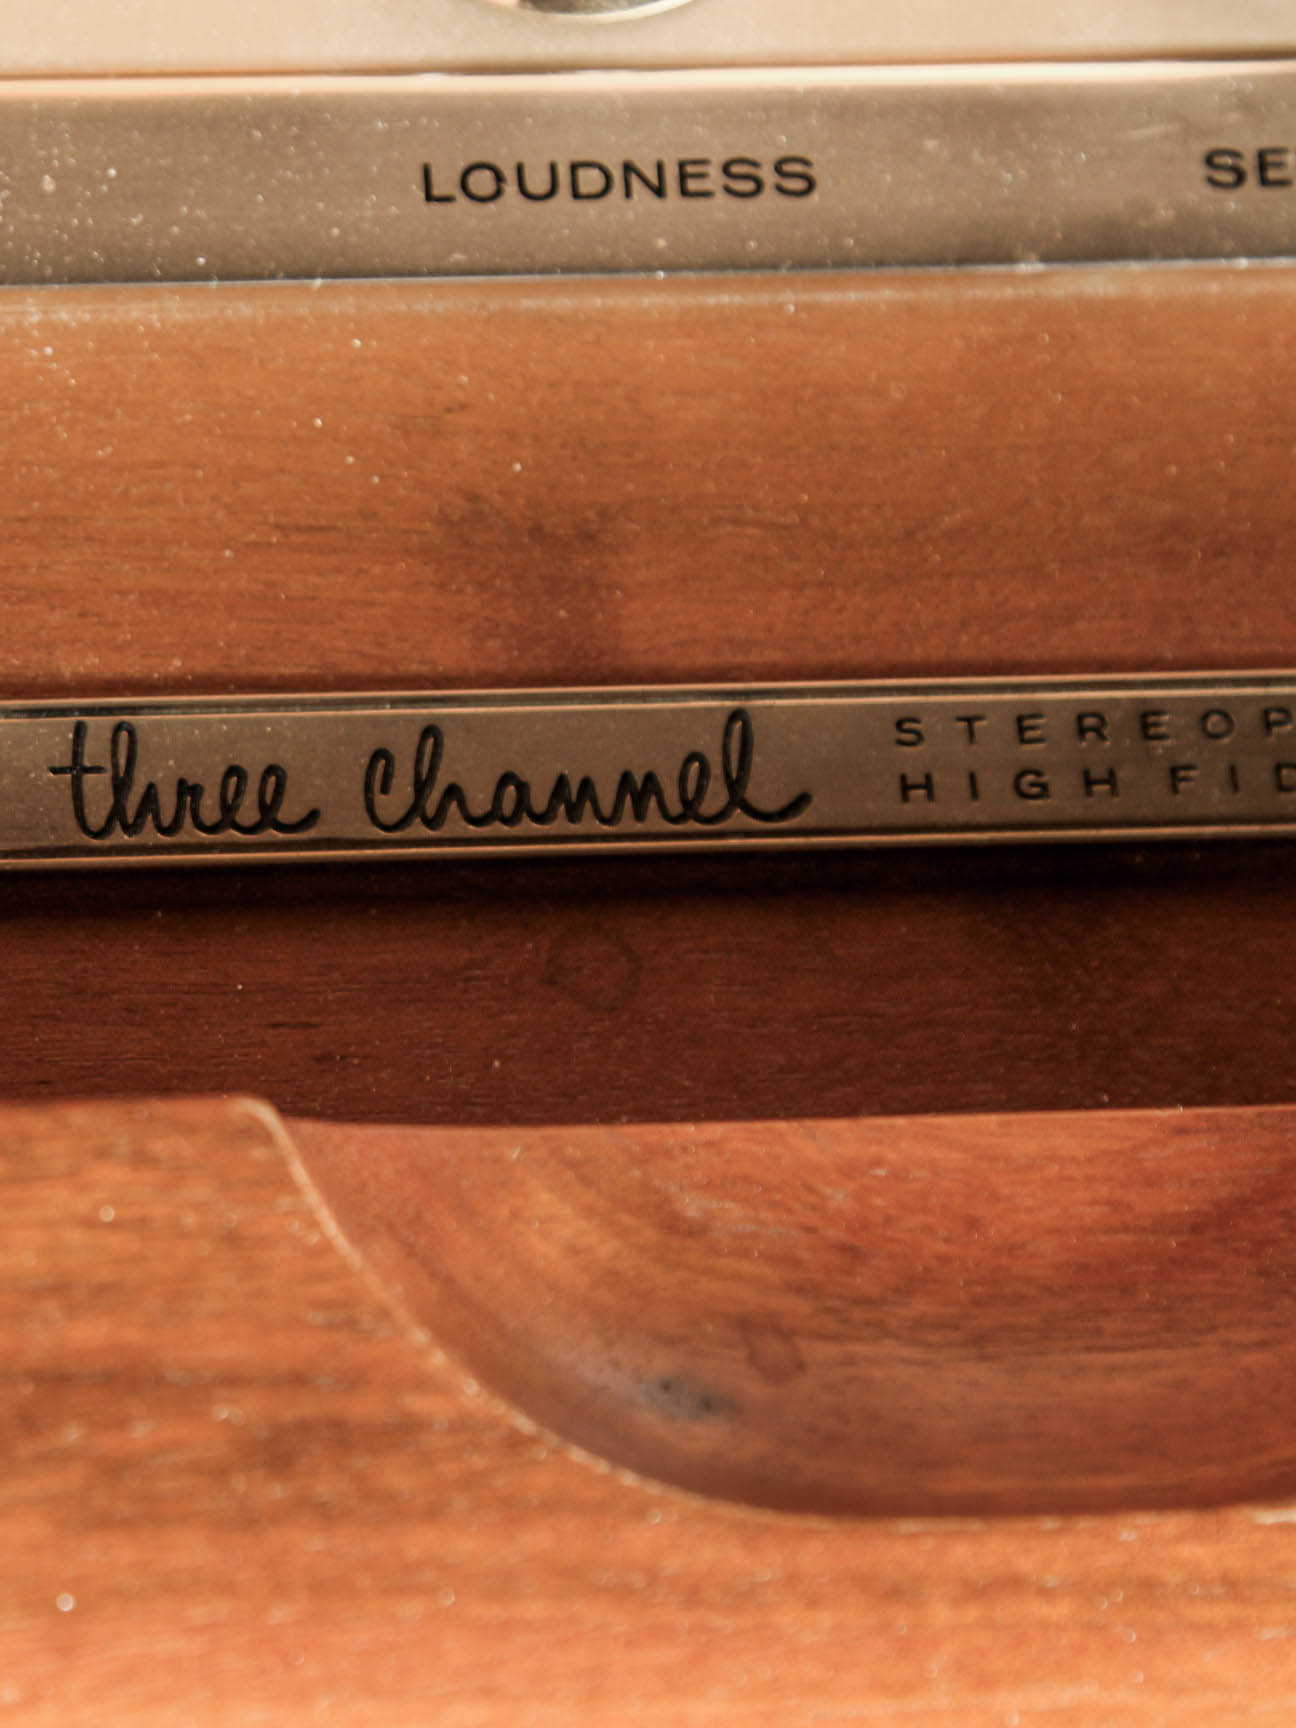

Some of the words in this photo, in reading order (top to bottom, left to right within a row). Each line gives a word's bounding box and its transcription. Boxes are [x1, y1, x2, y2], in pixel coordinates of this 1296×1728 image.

[422, 156, 817, 203] LOUDNESS
[1204, 148, 1293, 190] SE
[894, 707, 1293, 746] STEREOP
[49, 720, 320, 839] three
[899, 767, 1119, 803] HIGH
